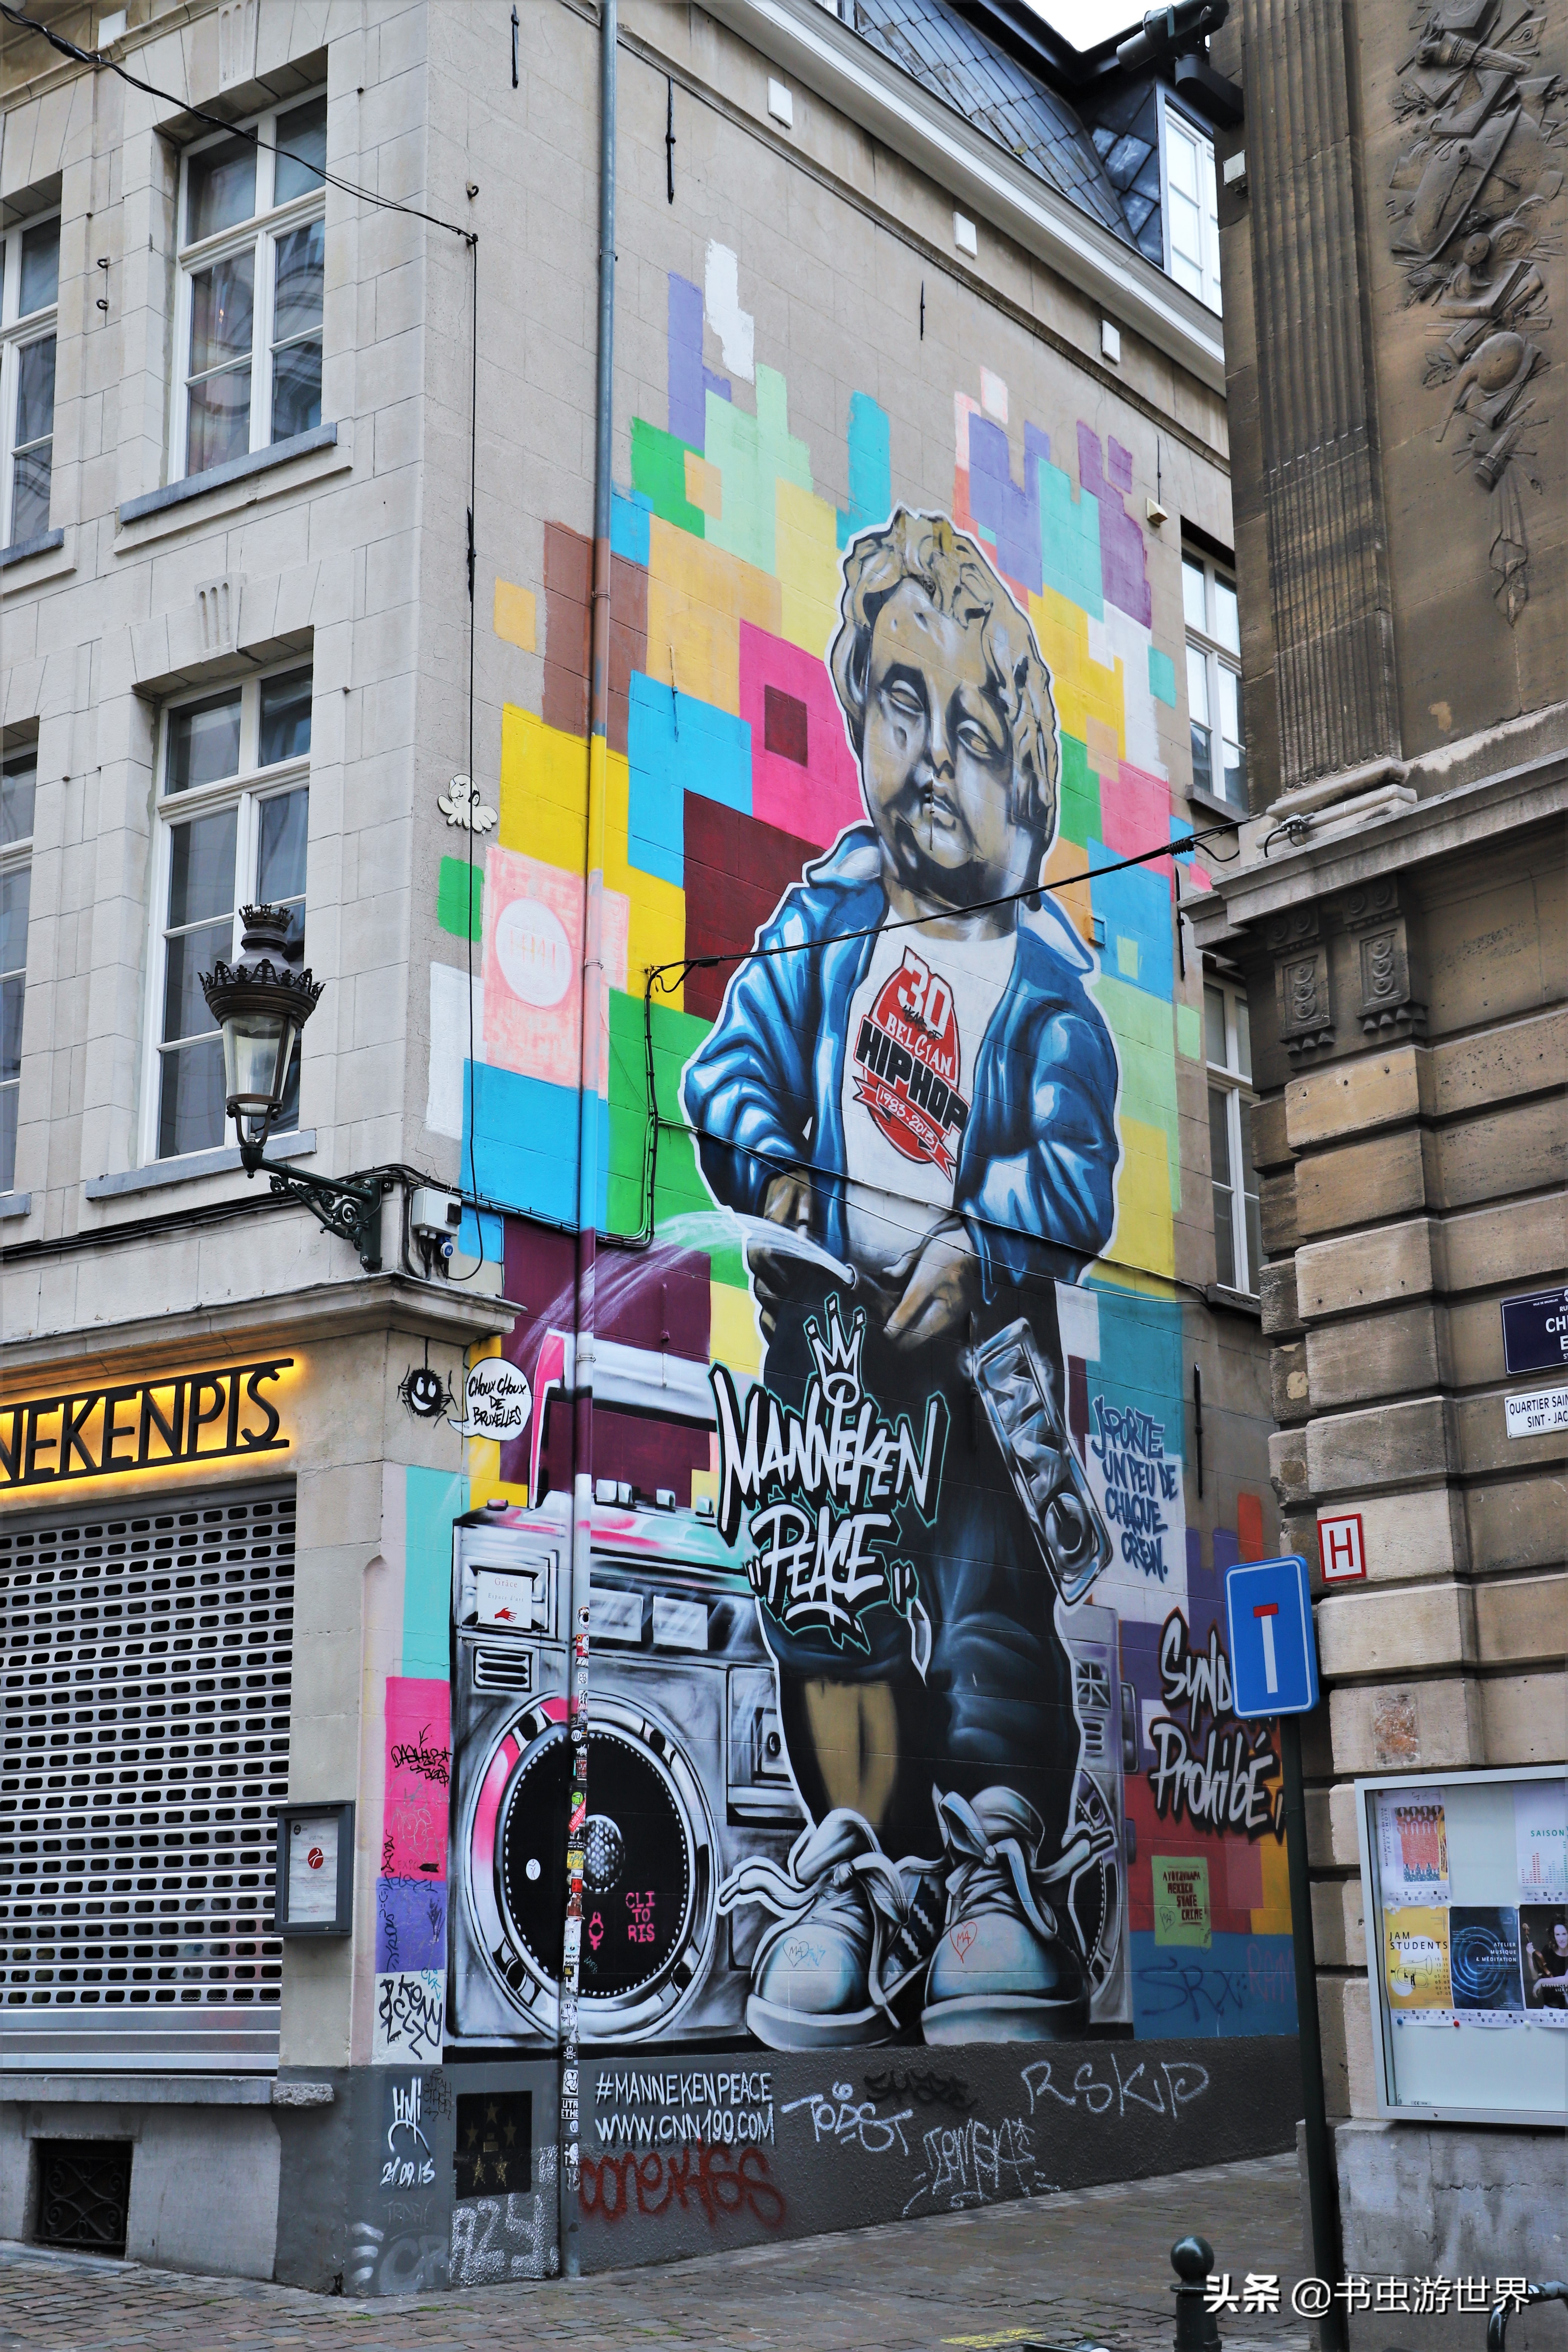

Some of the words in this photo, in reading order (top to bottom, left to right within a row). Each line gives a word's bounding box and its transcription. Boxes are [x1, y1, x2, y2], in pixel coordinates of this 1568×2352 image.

[897, 948, 952, 1037] 30
[885, 1012, 953, 1077] BELGIAN
[1546, 1315, 1568, 1333] CH
[489, 1395, 506, 1411] DE
[1510, 1397, 1549, 1416] QUARTIER
[472, 1405, 521, 1427] BRUXELLES
[1527, 1414, 1545, 1427] SINT
[712, 1367, 940, 1533] MANNEKEN
[1102, 1450, 1128, 1490] UN
[1127, 1453, 1156, 1497] PEU
[1157, 1461, 1178, 1501] DE
[1105, 1487, 1168, 1536] CHAQUE
[1329, 1527, 1354, 1570] H
[495, 1577, 518, 1588] Grâce
[569, 1816, 577, 1828] RADIO
[1167, 1882, 1193, 1894] MEXICO
[625, 1891, 655, 1908] CLI
[1176, 1894, 1197, 1908] STATE
[632, 1908, 651, 1923] TO
[1181, 1908, 1203, 1920] CRIME
[628, 1923, 655, 1943] RIS
[1390, 1931, 1410, 1941] JAM
[1390, 1942, 1448, 1950] STUDENTS
